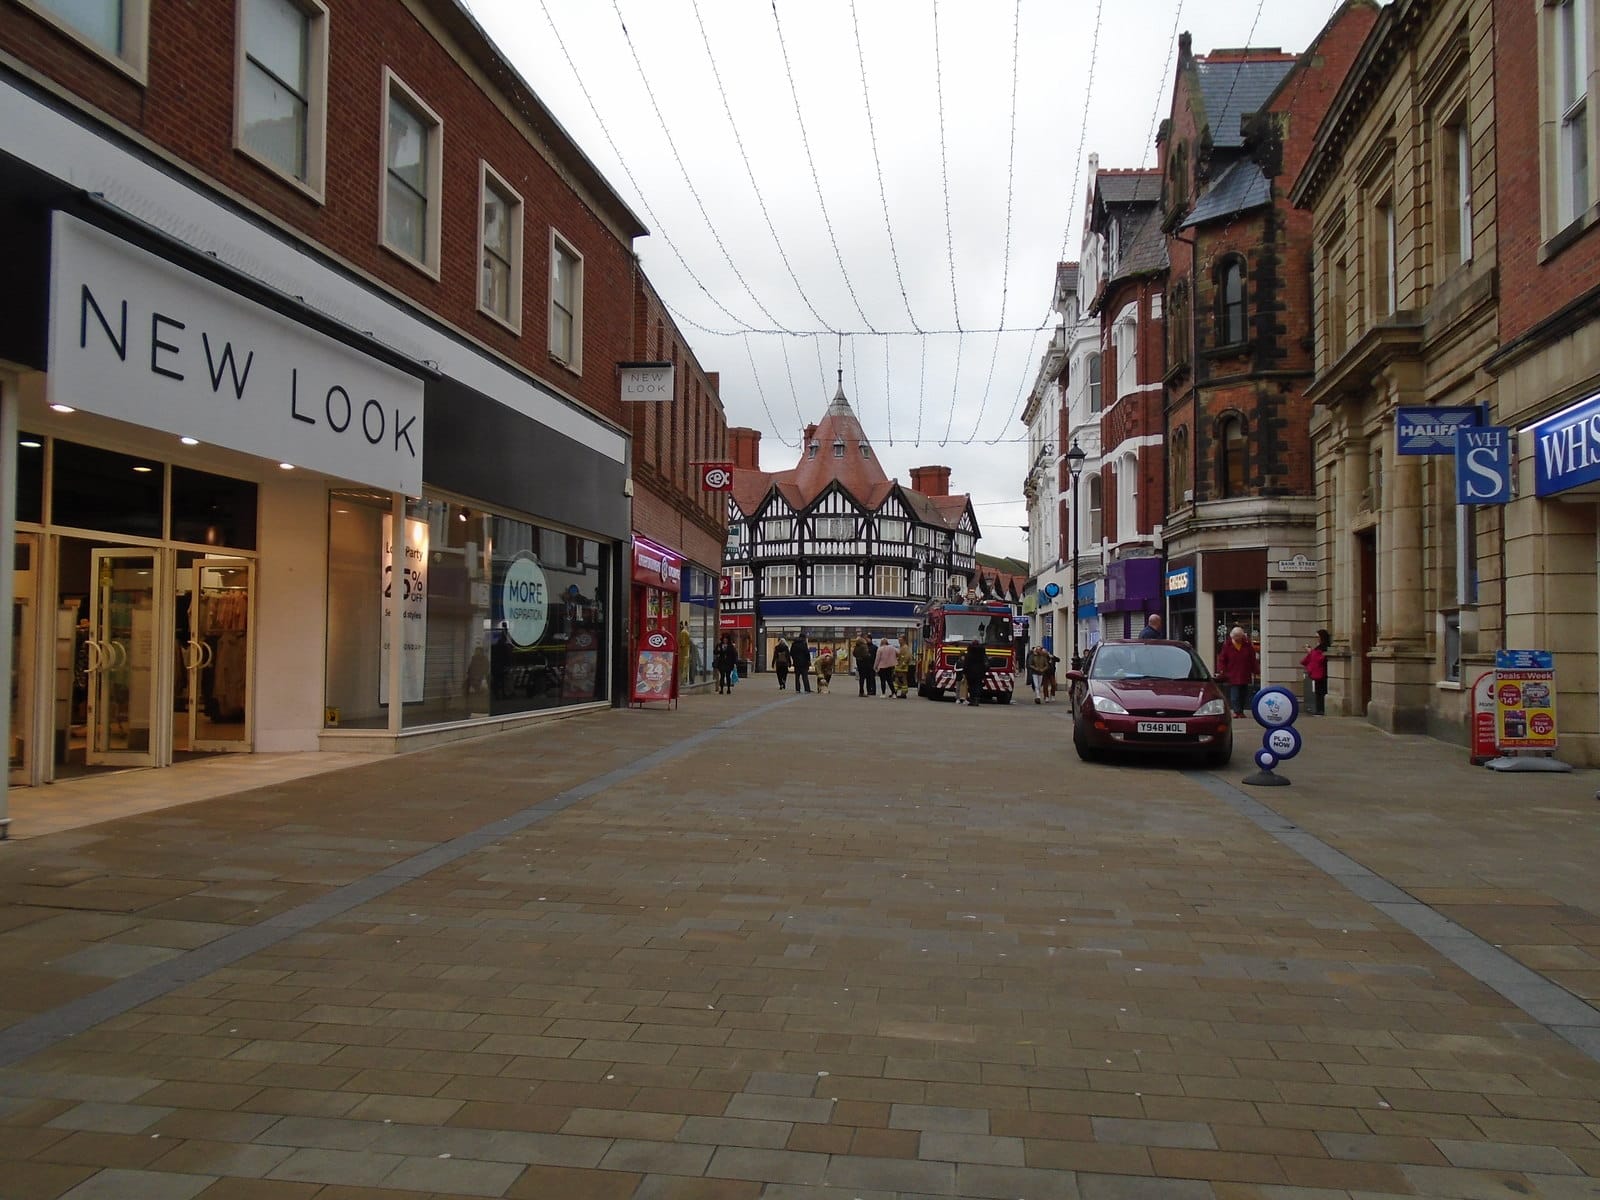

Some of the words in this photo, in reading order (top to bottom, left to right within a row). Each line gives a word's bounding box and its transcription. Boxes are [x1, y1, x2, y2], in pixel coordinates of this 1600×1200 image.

[80, 283, 254, 400] NEW
[291, 368, 416, 458] LOOK
[631, 373, 664, 382] NEW
[627, 384, 666, 393] LOOK
[1400, 424, 1471, 437] HALIFA
[1466, 431, 1501, 447] WH
[1466, 447, 1503, 498] S
[405, 545, 423, 562] Party
[410, 593, 422, 603] OFF
[509, 580, 543, 604] MORE
[509, 607, 543, 621] INSPIRATION
[646, 663, 664, 674] 24
[1496, 672, 1521, 680] Deals
[1527, 672, 1553, 680] Week
[1141, 723, 1164, 732] Y948
